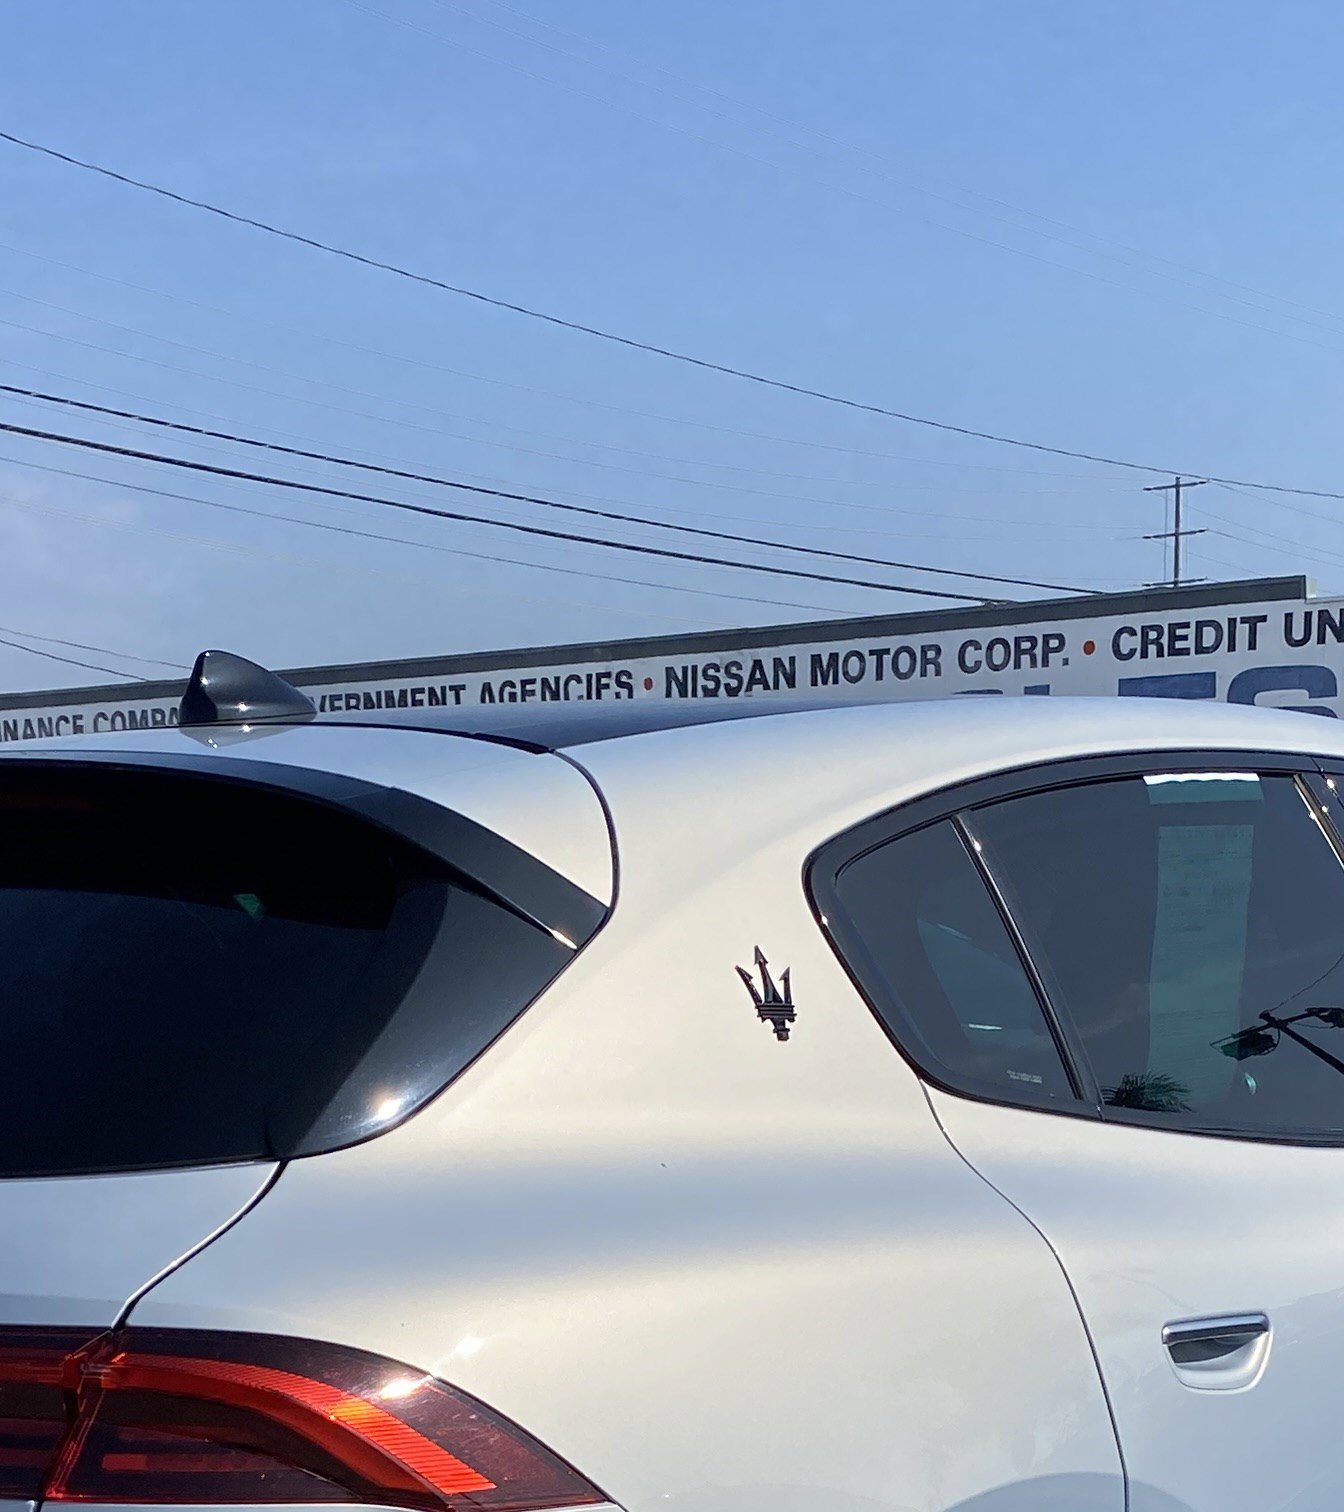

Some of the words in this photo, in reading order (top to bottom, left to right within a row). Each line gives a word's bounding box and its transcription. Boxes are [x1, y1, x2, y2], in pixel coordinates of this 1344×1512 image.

[1111, 613, 1268, 662] CREDIT
[479, 669, 634, 704] AGENCIES
[664, 655, 797, 699] NISSAN
[809, 641, 943, 687] MOTOR
[957, 632, 1070, 675] CORP.
